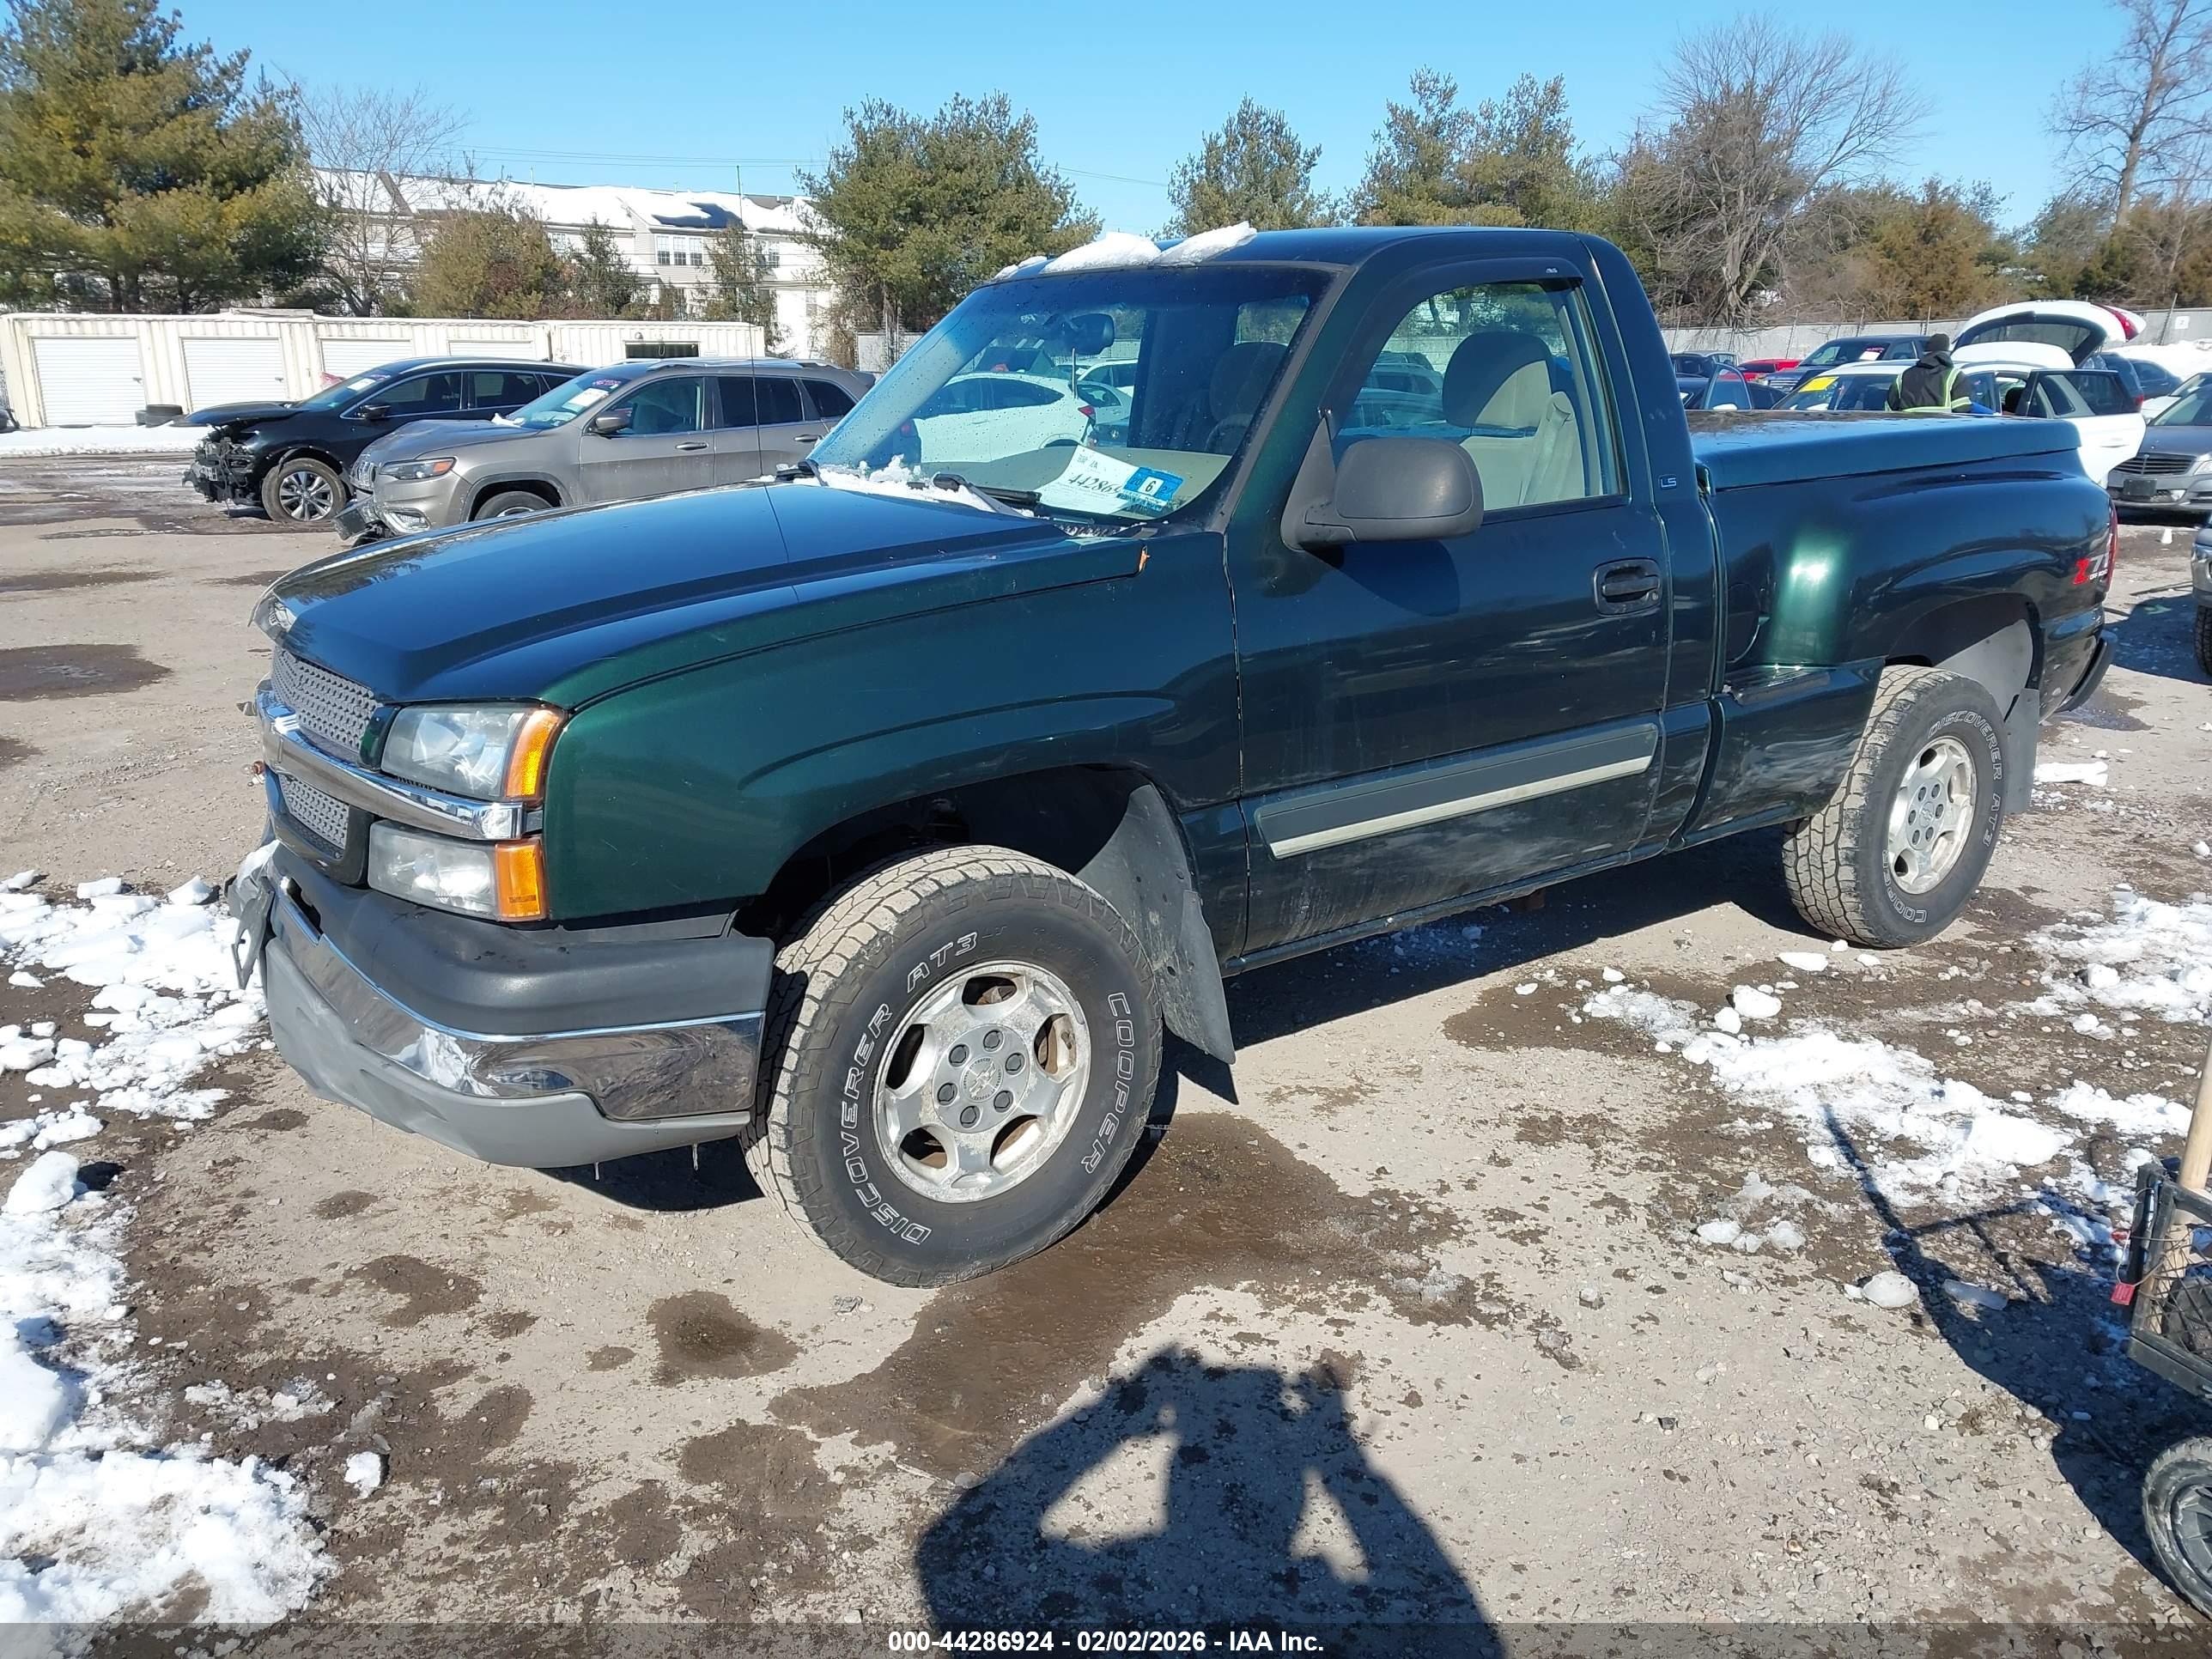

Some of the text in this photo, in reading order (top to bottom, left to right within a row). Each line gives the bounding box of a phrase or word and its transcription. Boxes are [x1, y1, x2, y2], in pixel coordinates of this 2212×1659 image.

[1146, 481, 1157, 492] 6
[1661, 477, 1676, 488] LS
[1928, 710, 2002, 848] DISCOVERER AT3
[841, 932, 977, 1245] DISCOVERER AT3
[1081, 992, 1135, 1174] COOPER
